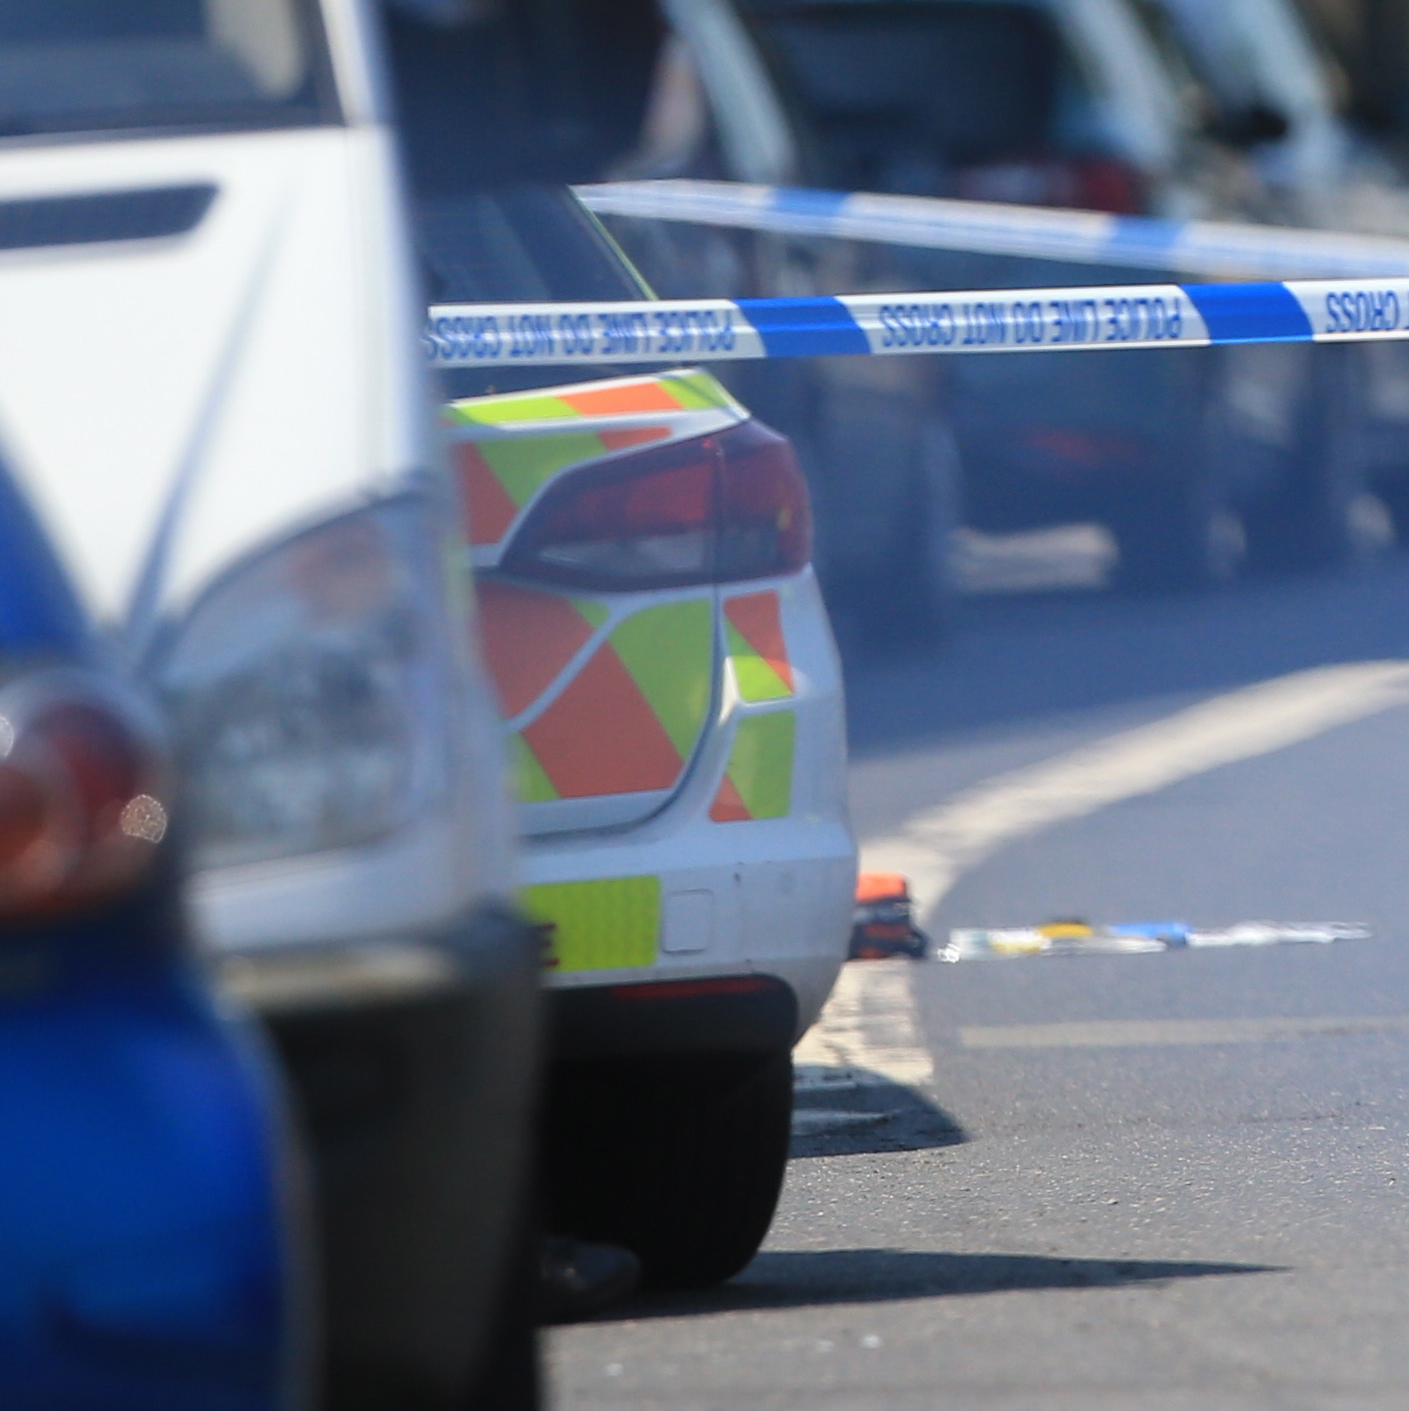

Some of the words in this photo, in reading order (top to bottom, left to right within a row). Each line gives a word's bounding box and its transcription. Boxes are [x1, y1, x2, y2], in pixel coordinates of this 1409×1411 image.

[658, 310, 736, 352] POLICE
[879, 303, 955, 346] CROSS
[964, 300, 1006, 344] NOT
[1014, 302, 1044, 342] DO
[1051, 299, 1098, 342] LINE
[1107, 297, 1182, 340] POLICE
[1326, 291, 1398, 332] CROSS
[510, 314, 552, 357] NOT
[563, 313, 593, 355] DO
[602, 313, 650, 355] LINE
